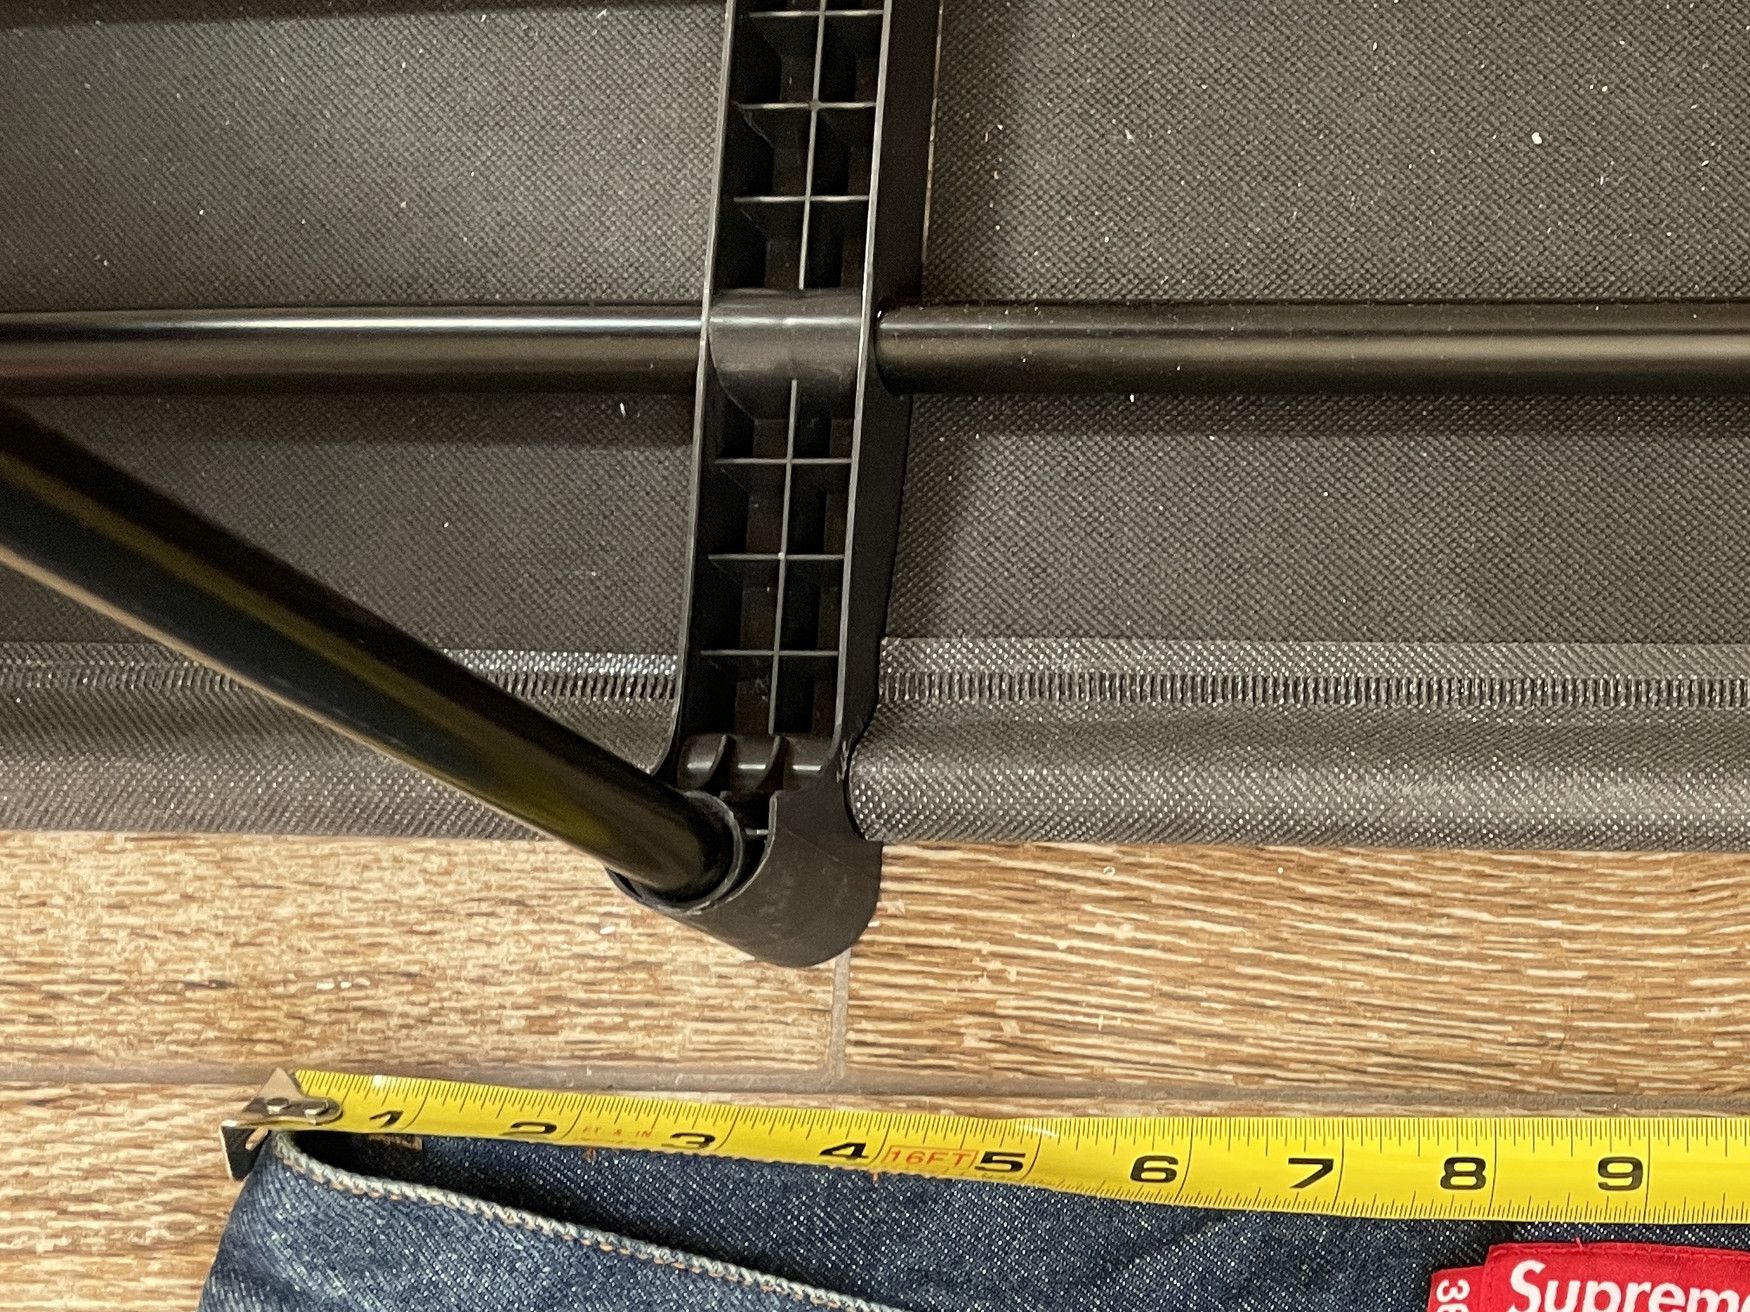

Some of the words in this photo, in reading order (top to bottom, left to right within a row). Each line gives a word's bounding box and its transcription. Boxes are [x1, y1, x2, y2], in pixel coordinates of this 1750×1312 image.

[370, 1110, 403, 1128] 1
[501, 1121, 557, 1136] 2
[661, 1132, 716, 1150] 3
[819, 1141, 869, 1161] 4
[887, 1148, 973, 1168] 16FT
[975, 1151, 1026, 1172] 5
[1130, 1155, 1180, 1183] 6
[1287, 1158, 1334, 1189] 7
[1440, 1157, 1486, 1190] 8
[1598, 1156, 1643, 1192] 9
